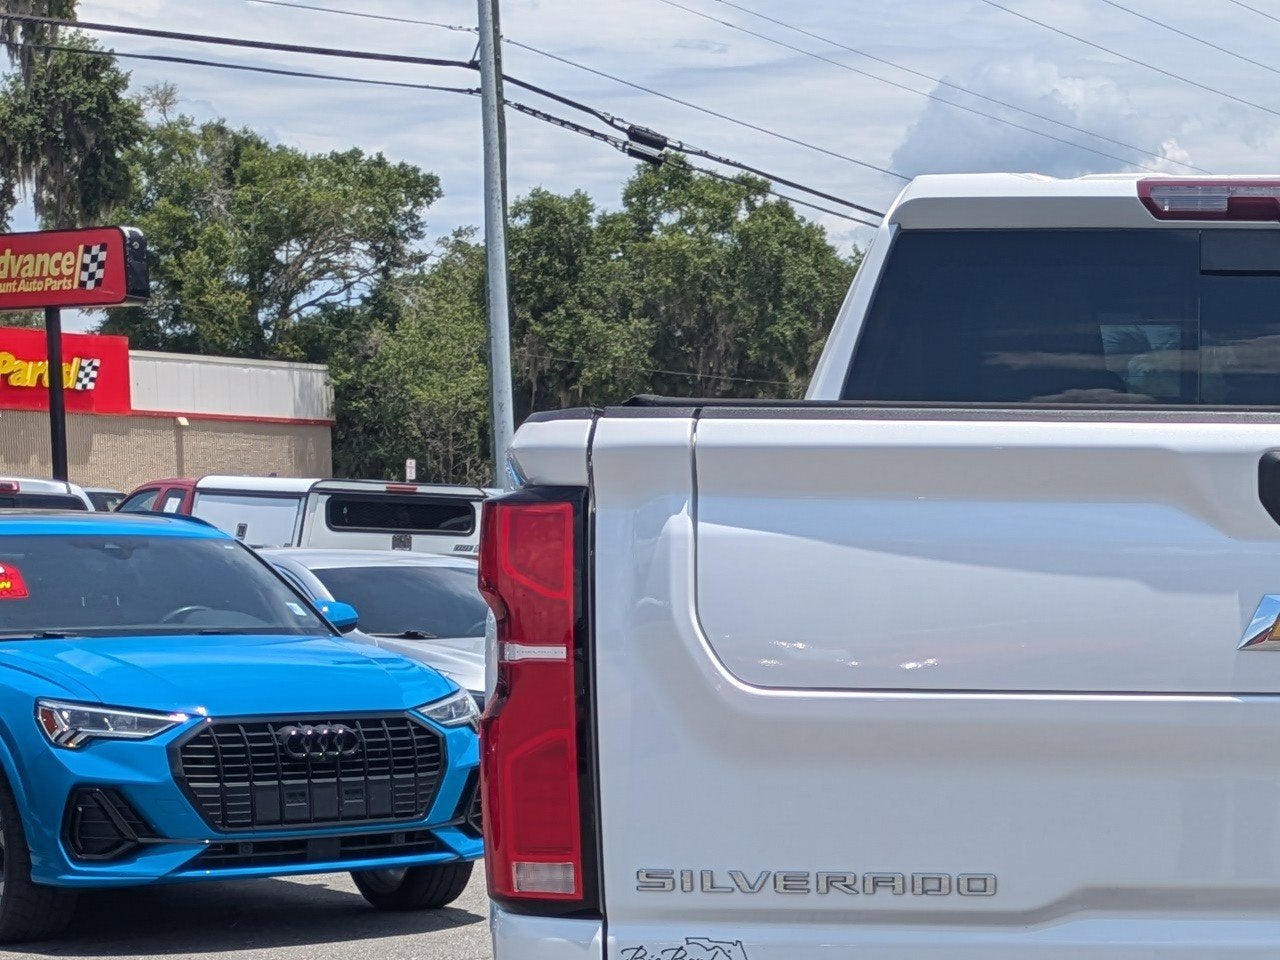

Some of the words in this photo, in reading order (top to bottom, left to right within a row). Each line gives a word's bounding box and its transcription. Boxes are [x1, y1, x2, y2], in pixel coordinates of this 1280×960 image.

[17, 278, 43, 292] Auto
[44, 277, 72, 291] Parts
[636, 868, 998, 896] SILVERADO
